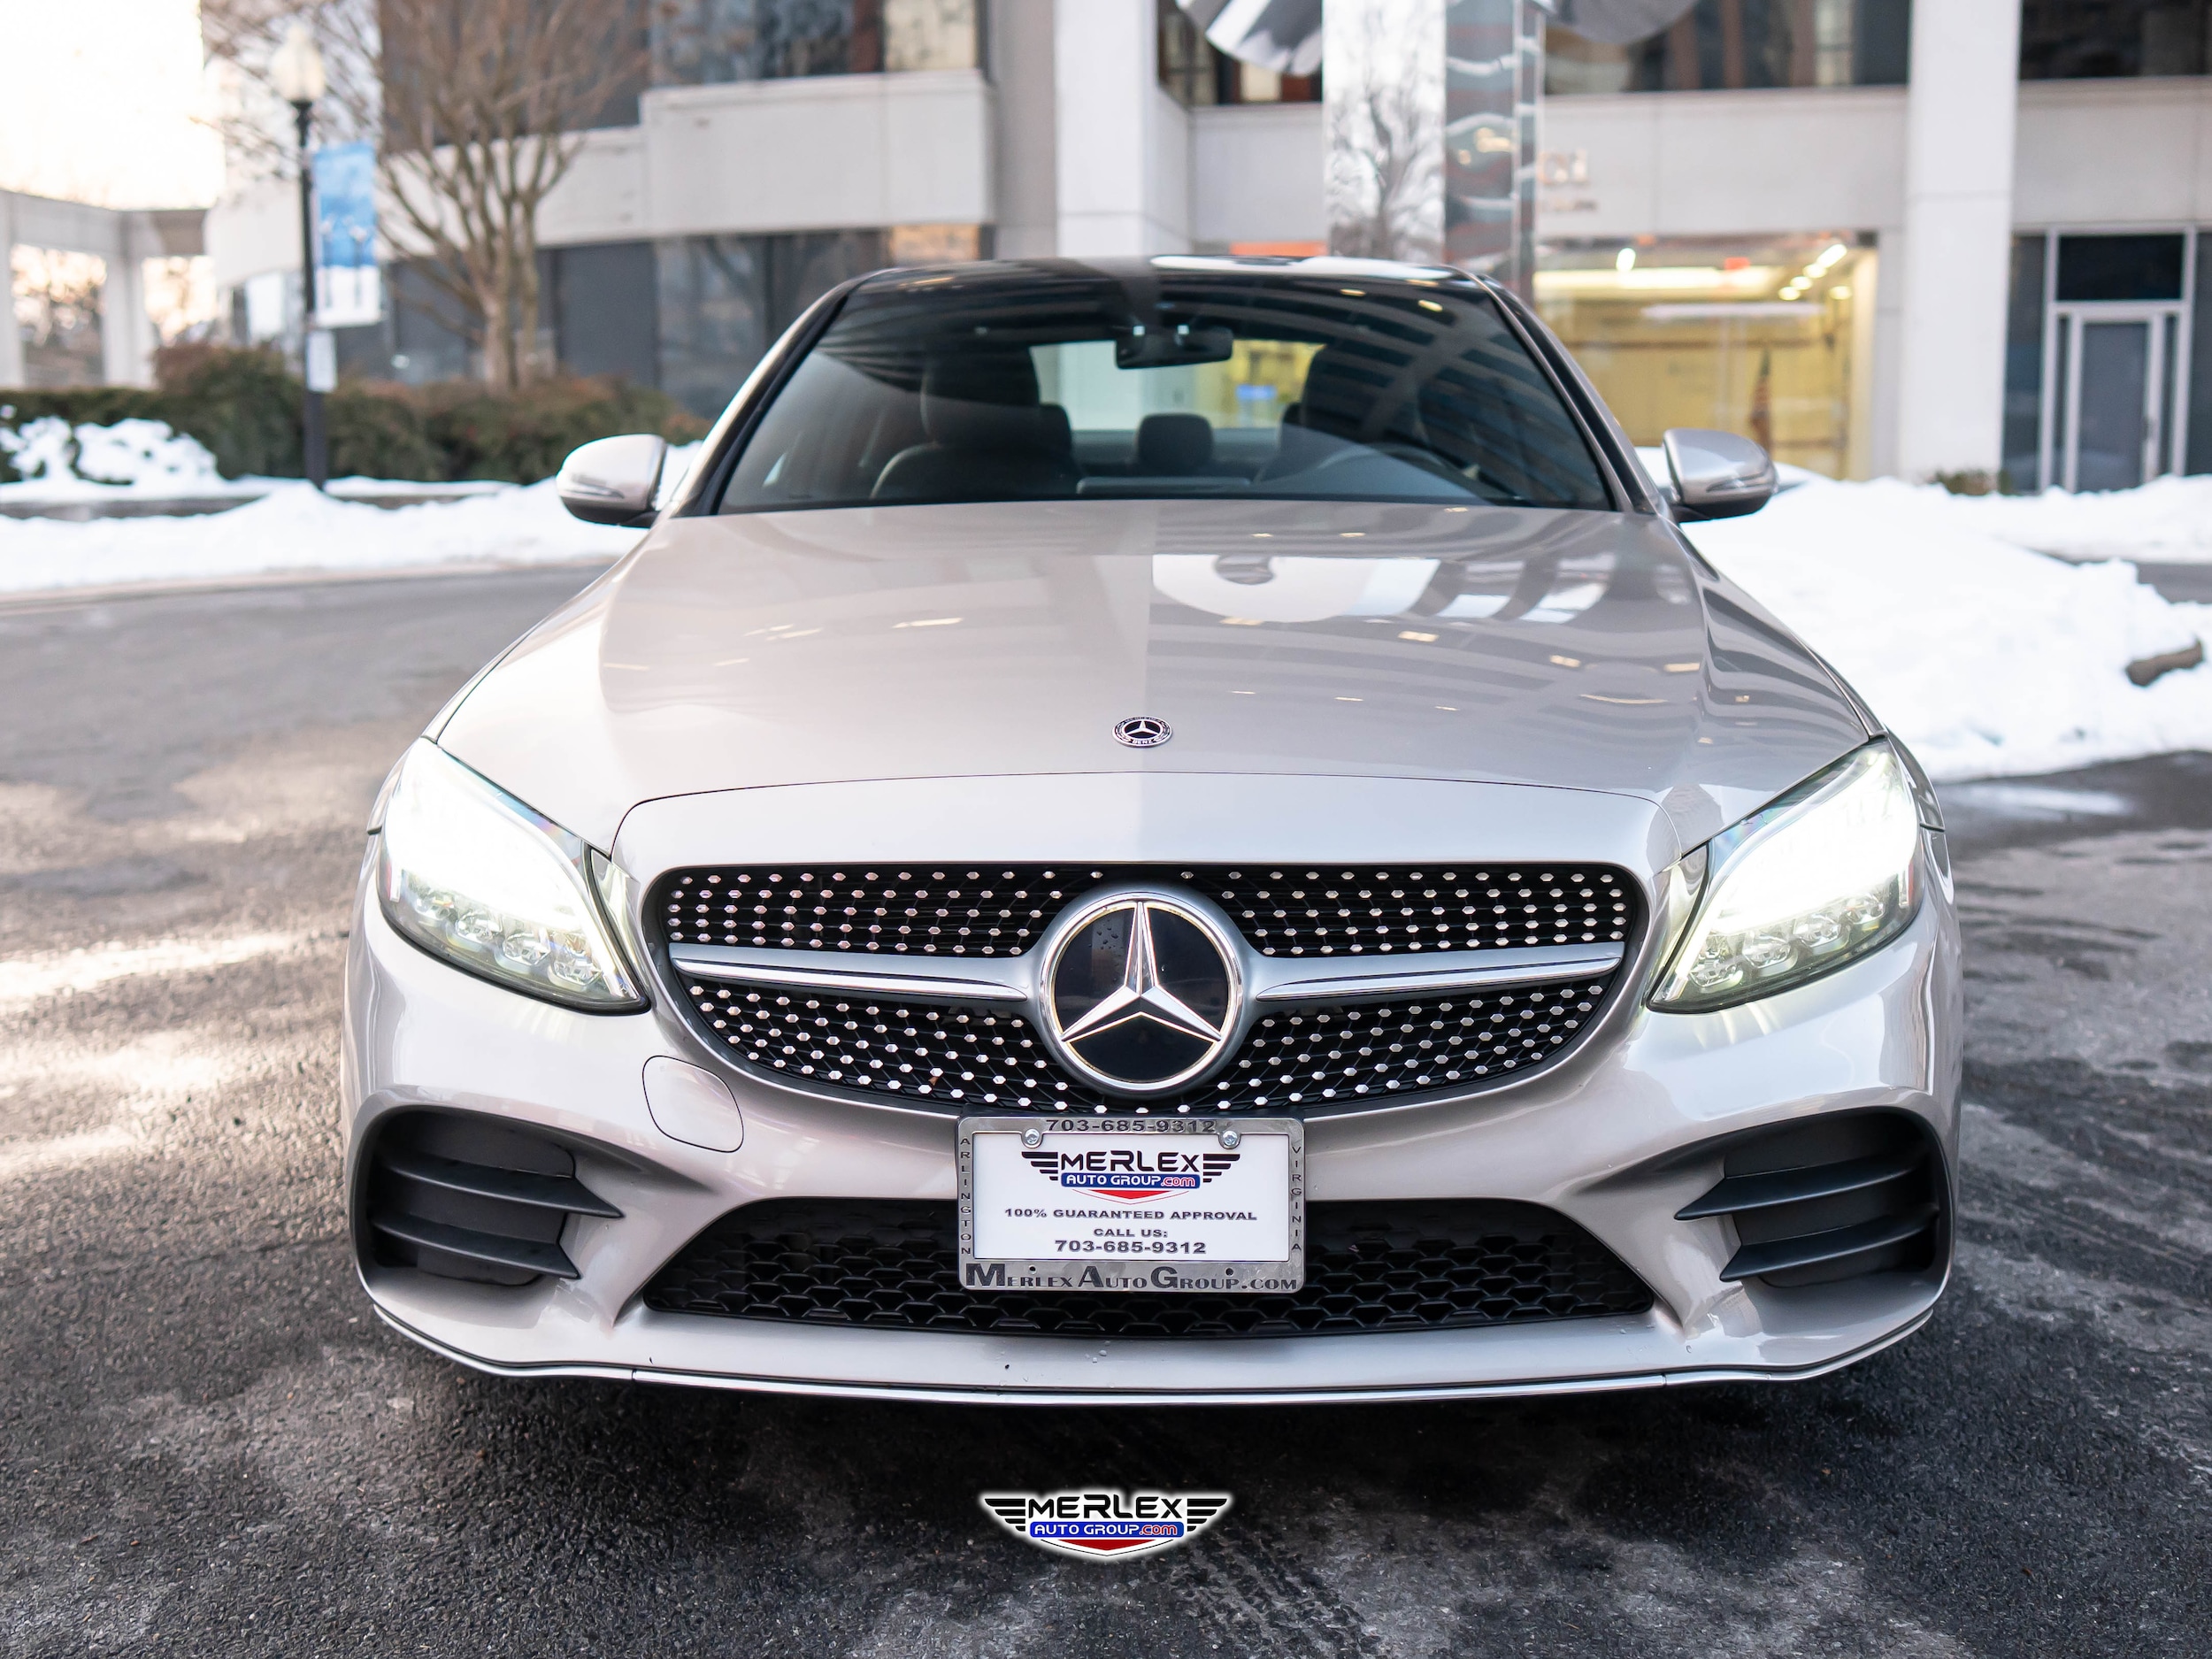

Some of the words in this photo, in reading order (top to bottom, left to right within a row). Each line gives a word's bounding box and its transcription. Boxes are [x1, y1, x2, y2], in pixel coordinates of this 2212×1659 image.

[1045, 1119, 1217, 1133] 703-685-9312
[1061, 1150, 1200, 1172] MERLEX
[1066, 1174, 1107, 1185] AUTO
[1004, 1208, 1048, 1217] 100%
[1053, 1209, 1165, 1220] GUARANTEED
[1170, 1210, 1258, 1221] APPROVAL
[1093, 1228, 1135, 1238] CALL
[1141, 1228, 1169, 1238] US:
[1054, 1240, 1207, 1255] 703-685-9312
